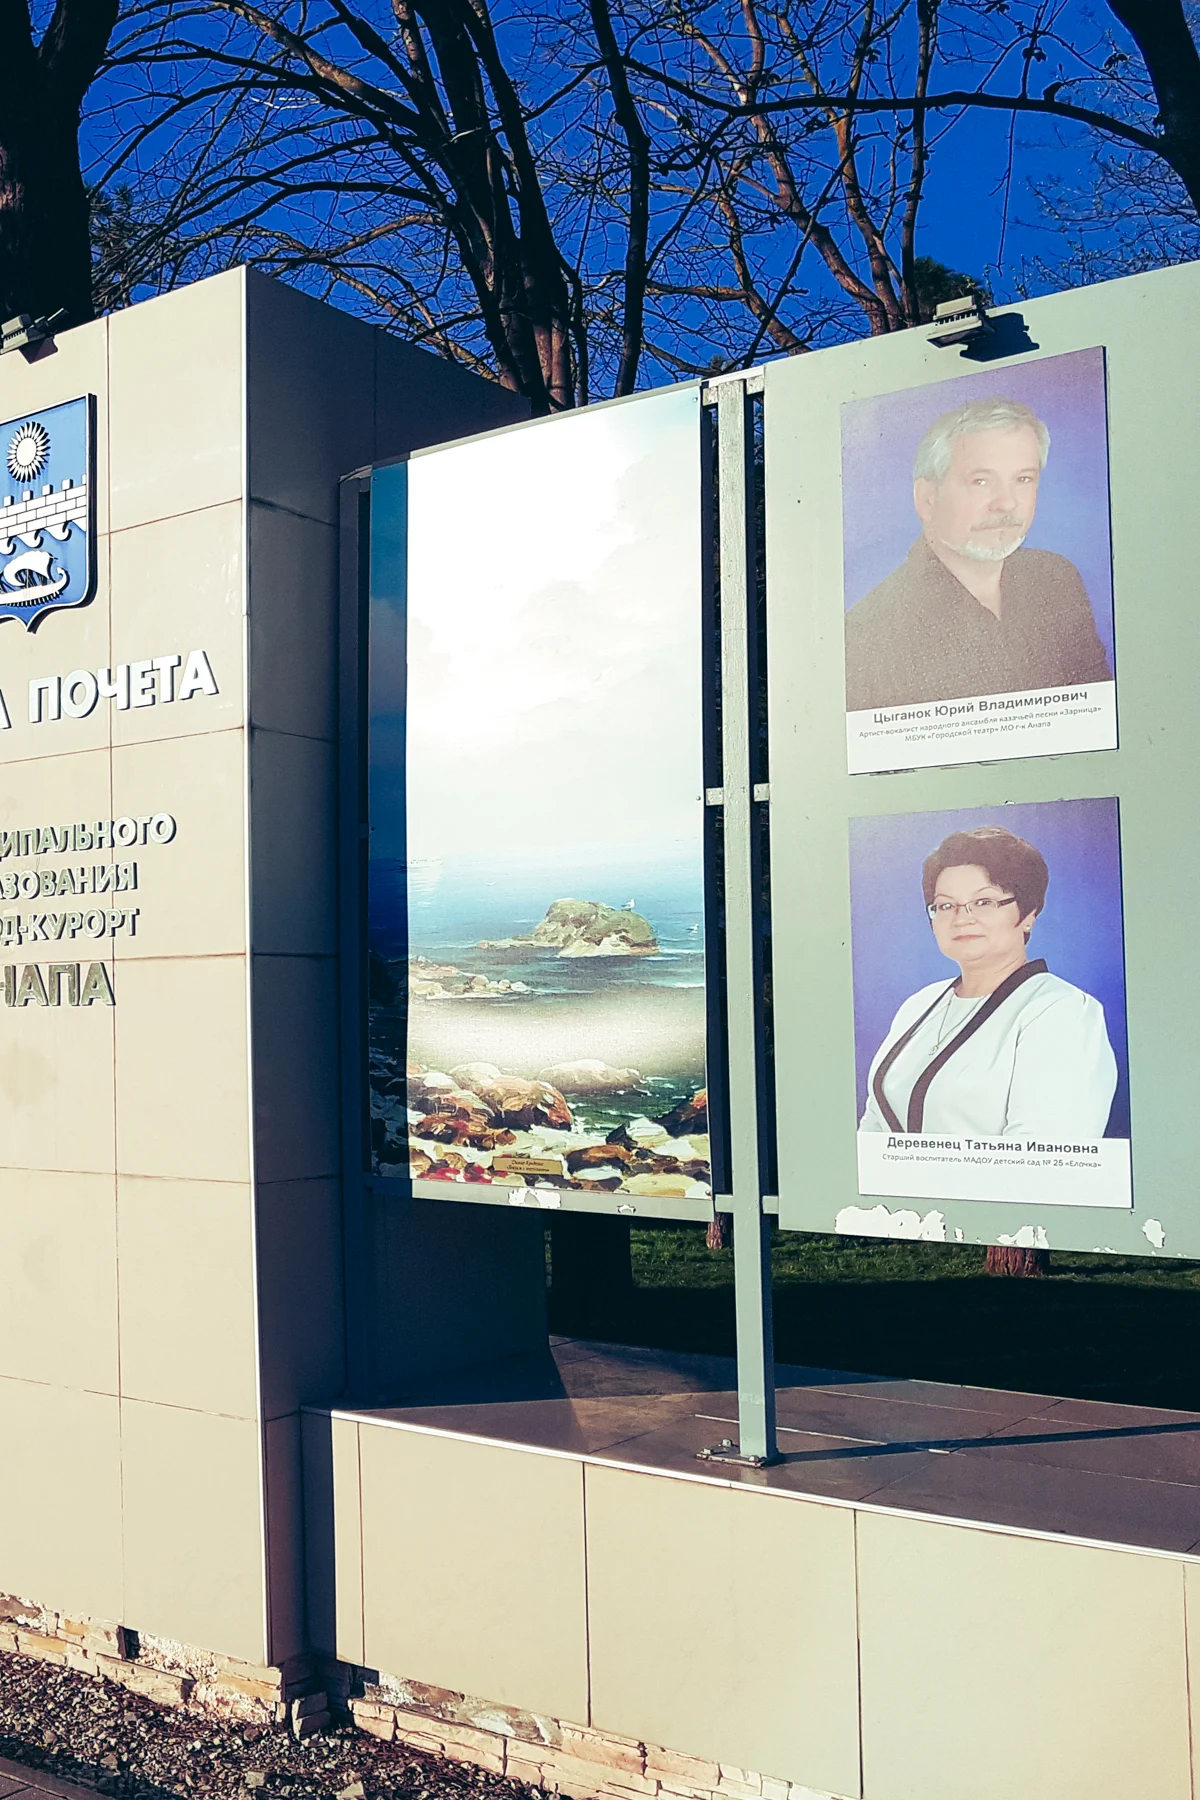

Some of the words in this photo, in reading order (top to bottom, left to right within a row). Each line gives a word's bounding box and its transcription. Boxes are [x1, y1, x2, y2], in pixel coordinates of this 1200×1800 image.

[28, 649, 219, 723] ПОЧЕТА
[873, 708, 931, 724] Цыганок
[935, 702, 974, 717] Юрий
[979, 691, 1088, 711] Владимирович
[859, 726, 918, 738] Артист-вокалист
[920, 721, 960, 731] народного
[961, 717, 998, 727] ансамбля
[1000, 712, 1034, 722] казачьей
[1035, 711, 1058, 719] песни
[905, 734, 926, 742] МБУК
[928, 730, 972, 740] «Городской
[1027, 720, 1051, 730] Анапа
[887, 1137, 962, 1151] Деревенец
[965, 1139, 1022, 1152] Татьяна
[1026, 1141, 1099, 1154] Ивановна
[882, 1153, 914, 1162] Старший
[915, 1155, 962, 1163] воспитатель
[963, 1156, 993, 1165] МАДОУ
[993, 1158, 1025, 1166] детский
[1026, 1159, 1041, 1167] сад
[1053, 1159, 1064, 1167] 25
